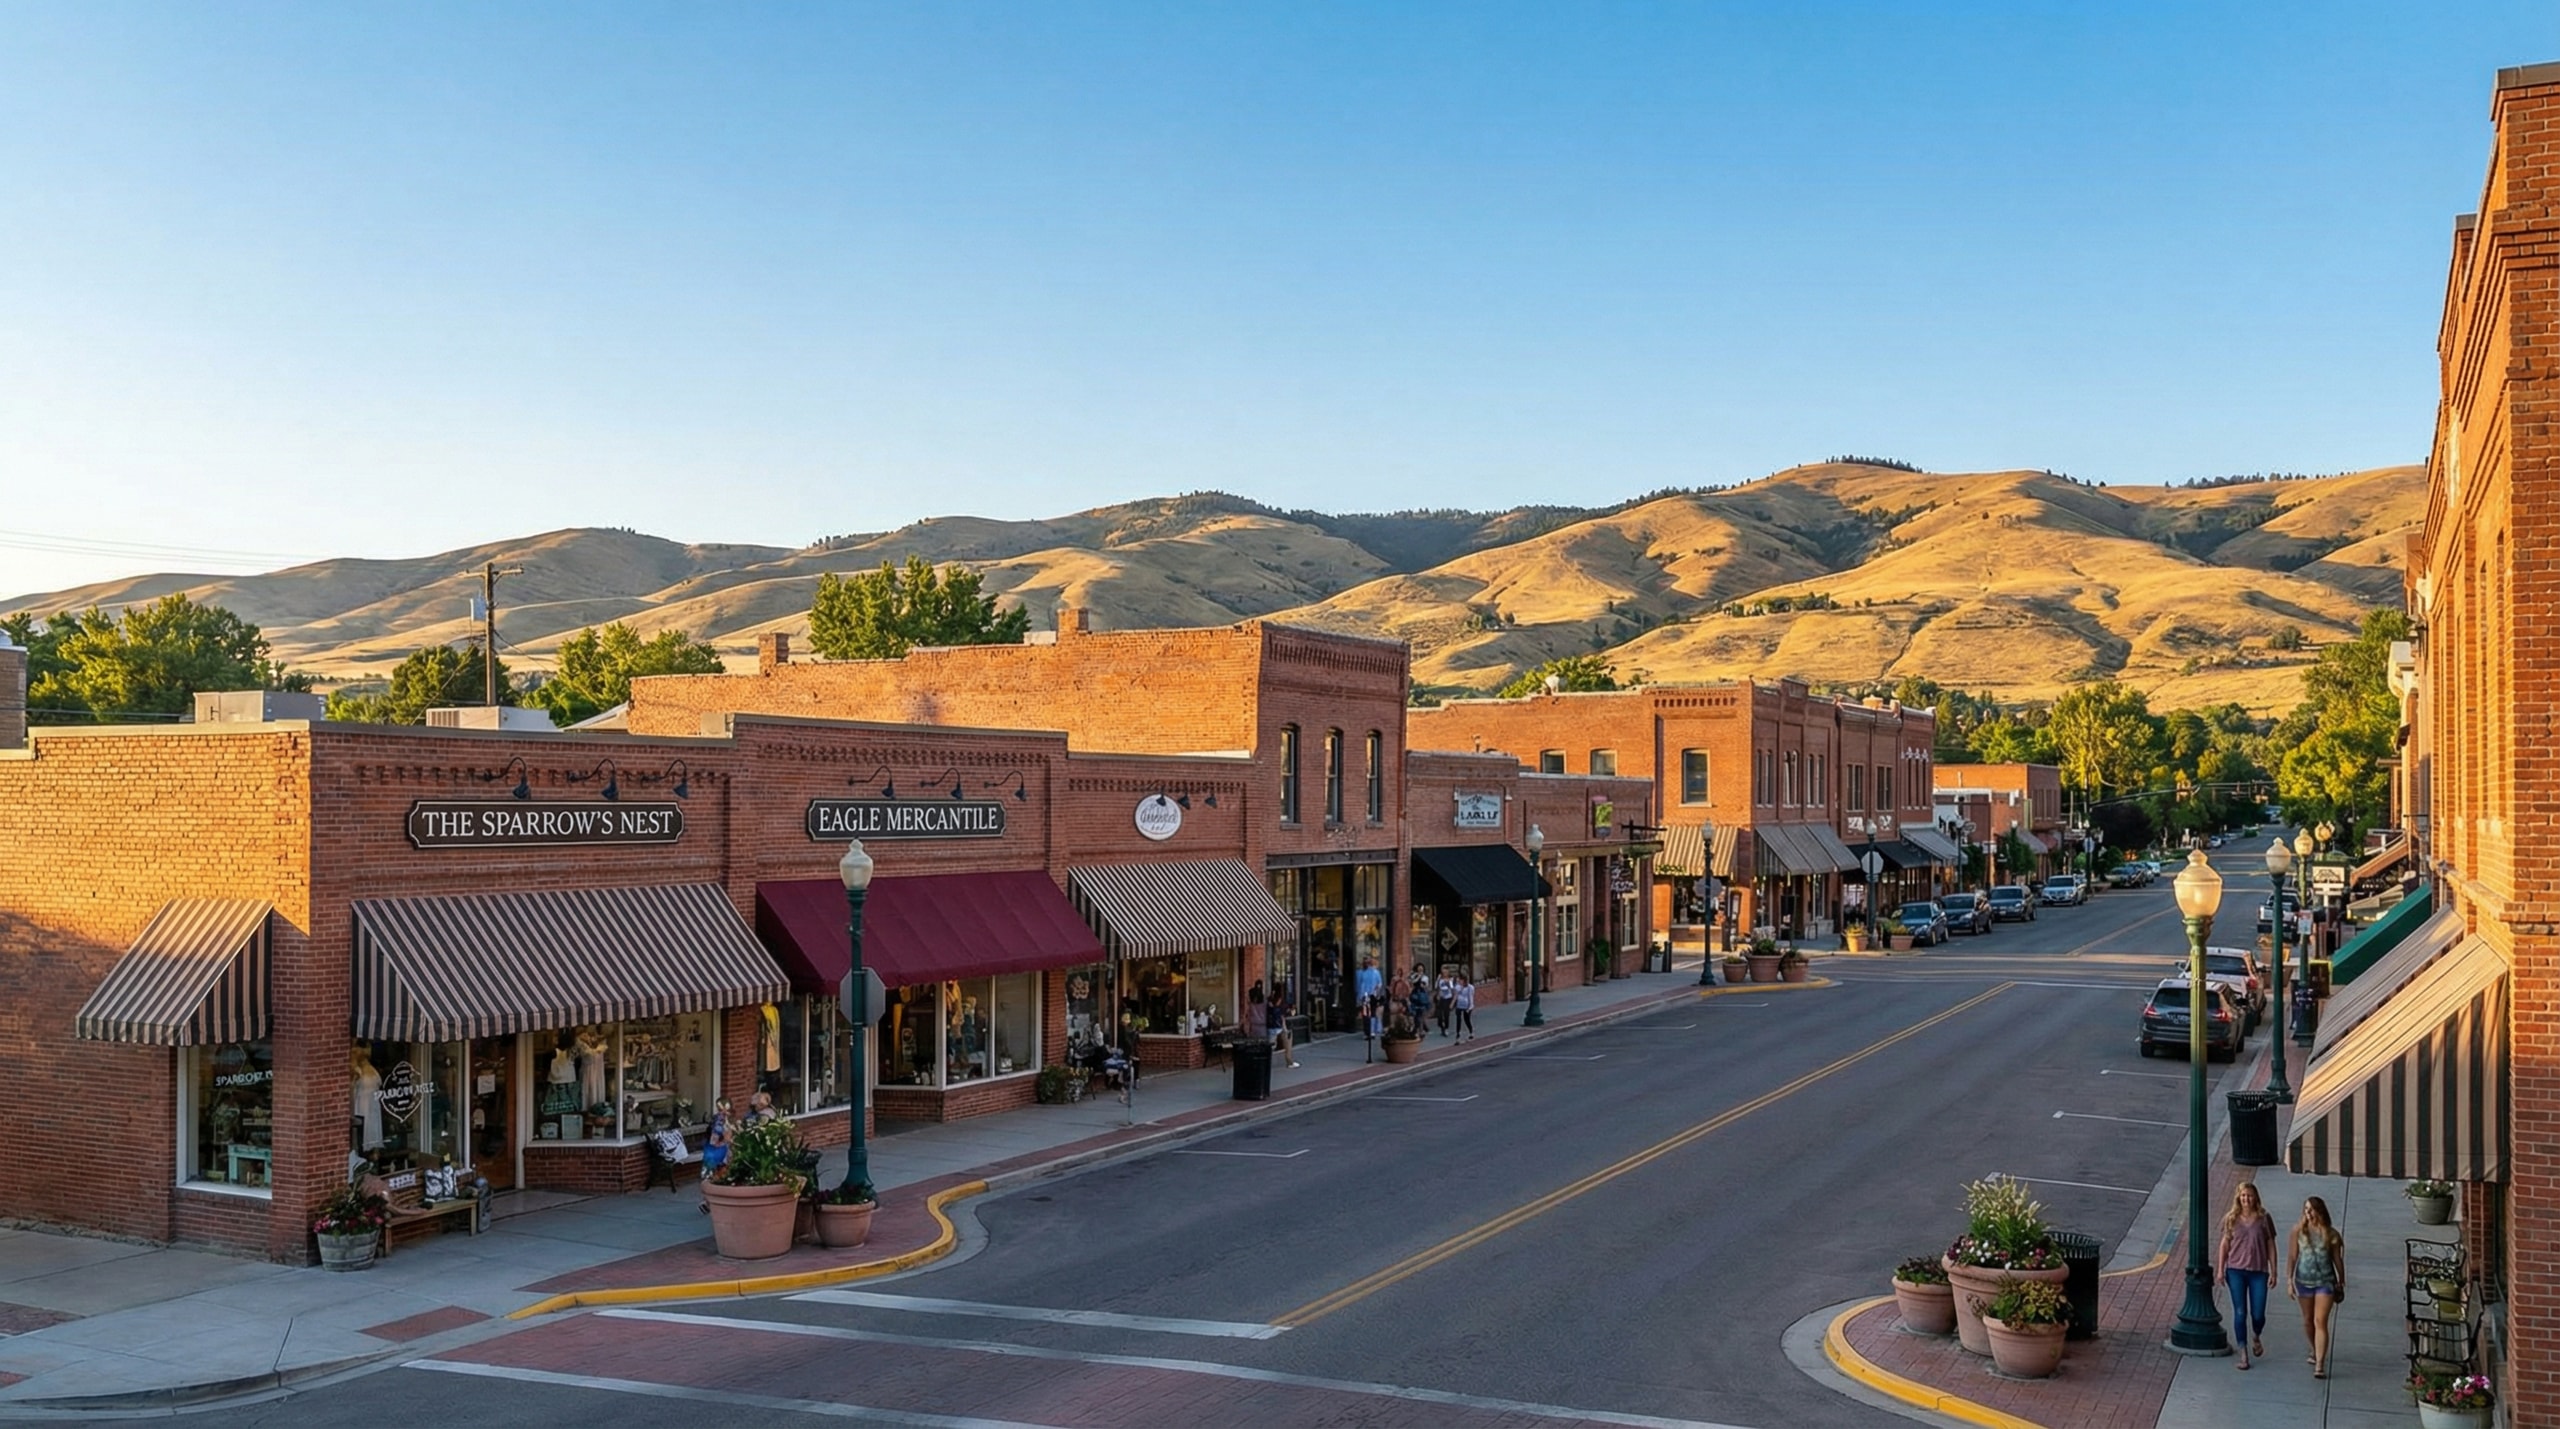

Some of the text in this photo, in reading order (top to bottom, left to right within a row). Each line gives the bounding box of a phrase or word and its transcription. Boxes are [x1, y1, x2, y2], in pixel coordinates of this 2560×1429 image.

[422, 810, 674, 837] THE SPARROW'S NEST
[818, 807, 998, 832] EAGLE MERCANTILE
